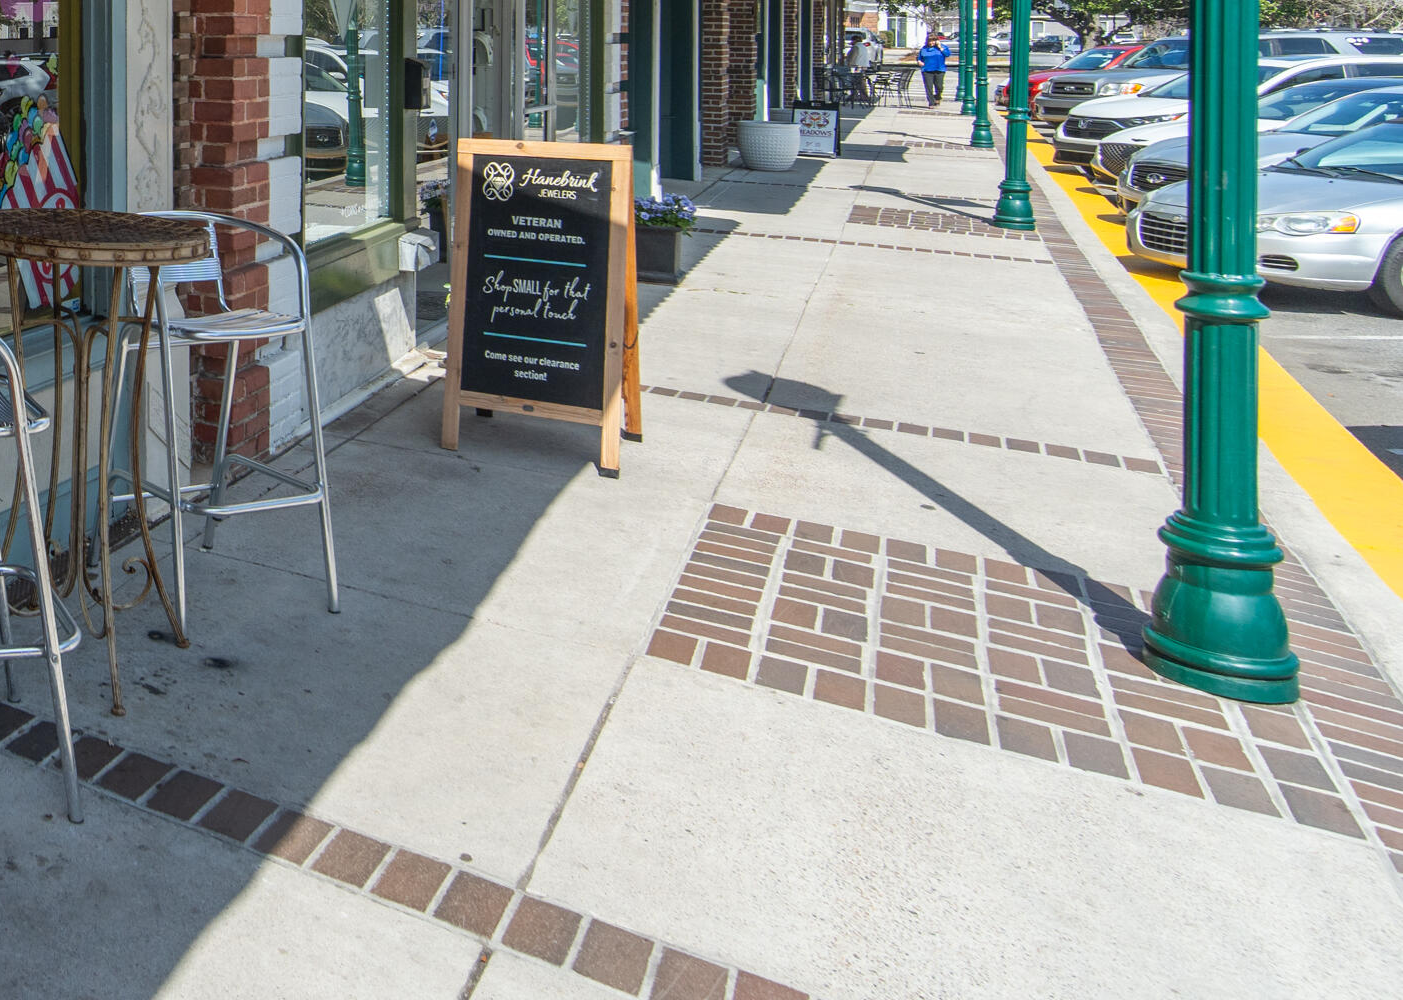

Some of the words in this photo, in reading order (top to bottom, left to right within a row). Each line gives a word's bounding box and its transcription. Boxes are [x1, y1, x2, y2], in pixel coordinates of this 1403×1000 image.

[519, 168, 599, 193] Hanebrink
[538, 188, 577, 200] JEWELERS
[511, 215, 563, 230] VETERAN
[487, 228, 517, 239] OWNED
[519, 231, 536, 240] AND
[538, 232, 586, 245] OPERATED.
[512, 279, 542, 295] SMALL
[543, 281, 560, 302] for
[564, 276, 591, 301] that
[490, 298, 543, 323] personal
[543, 299, 578, 320] touch
[484, 350, 507, 361] Come
[508, 354, 523, 363] see
[524, 356, 538, 365] our
[538, 357, 580, 371] clearance
[513, 369, 547, 381] section!
